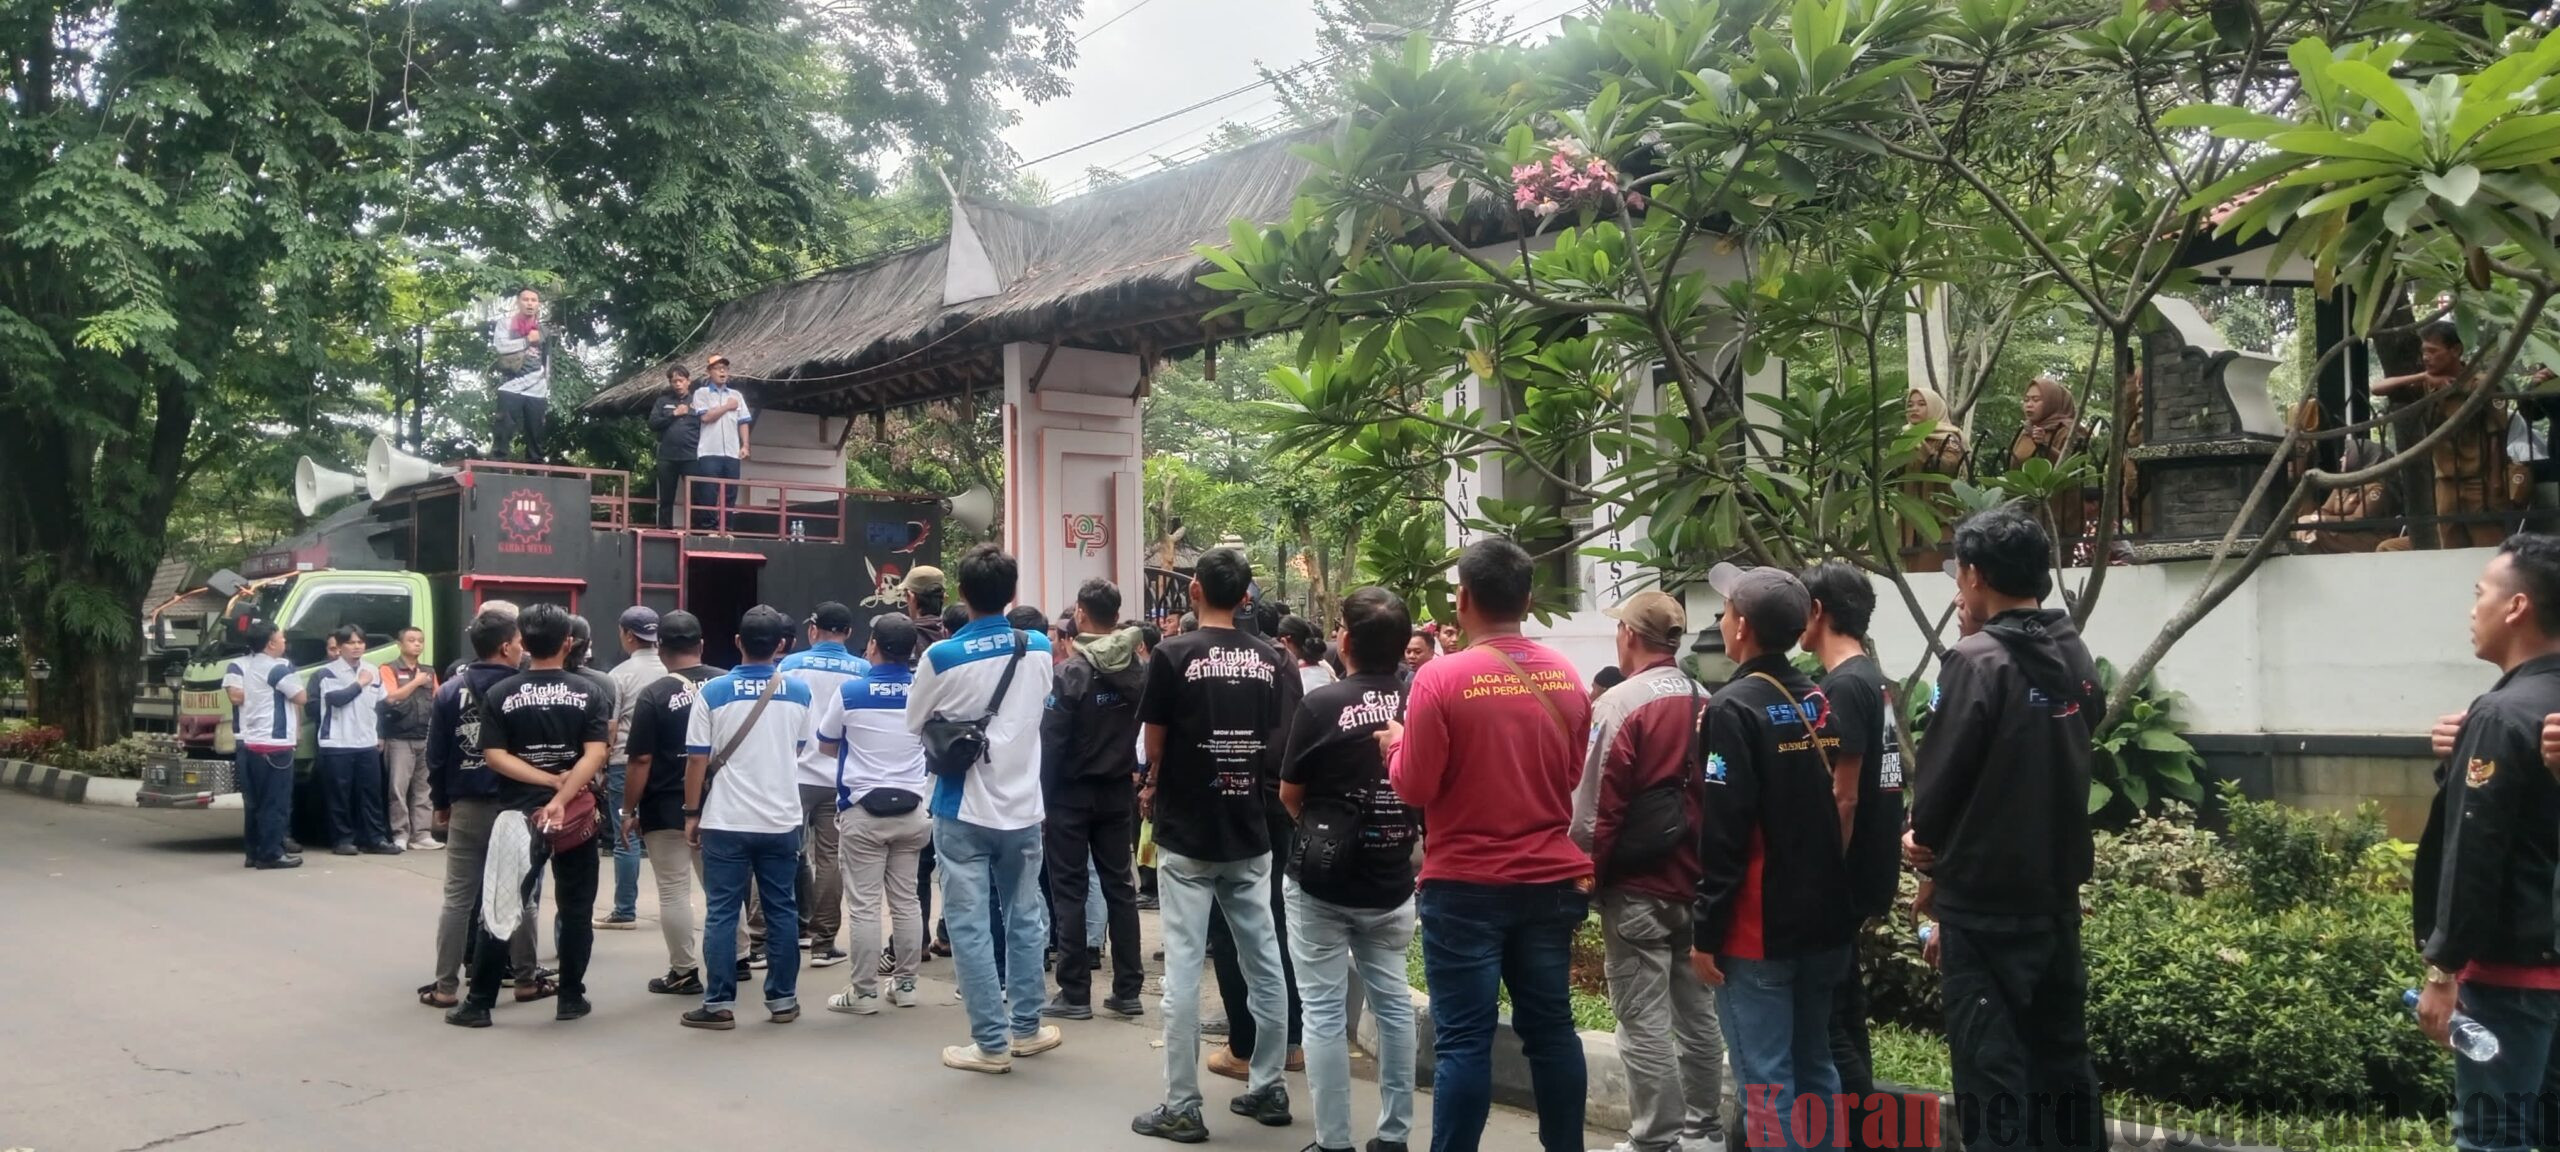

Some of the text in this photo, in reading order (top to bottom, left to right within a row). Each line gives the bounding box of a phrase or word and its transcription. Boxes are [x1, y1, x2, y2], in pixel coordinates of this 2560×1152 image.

[802, 655, 861, 673] FSPMI
[1209, 645, 1260, 667] Eighth
[1463, 686, 1491, 699] DAN
